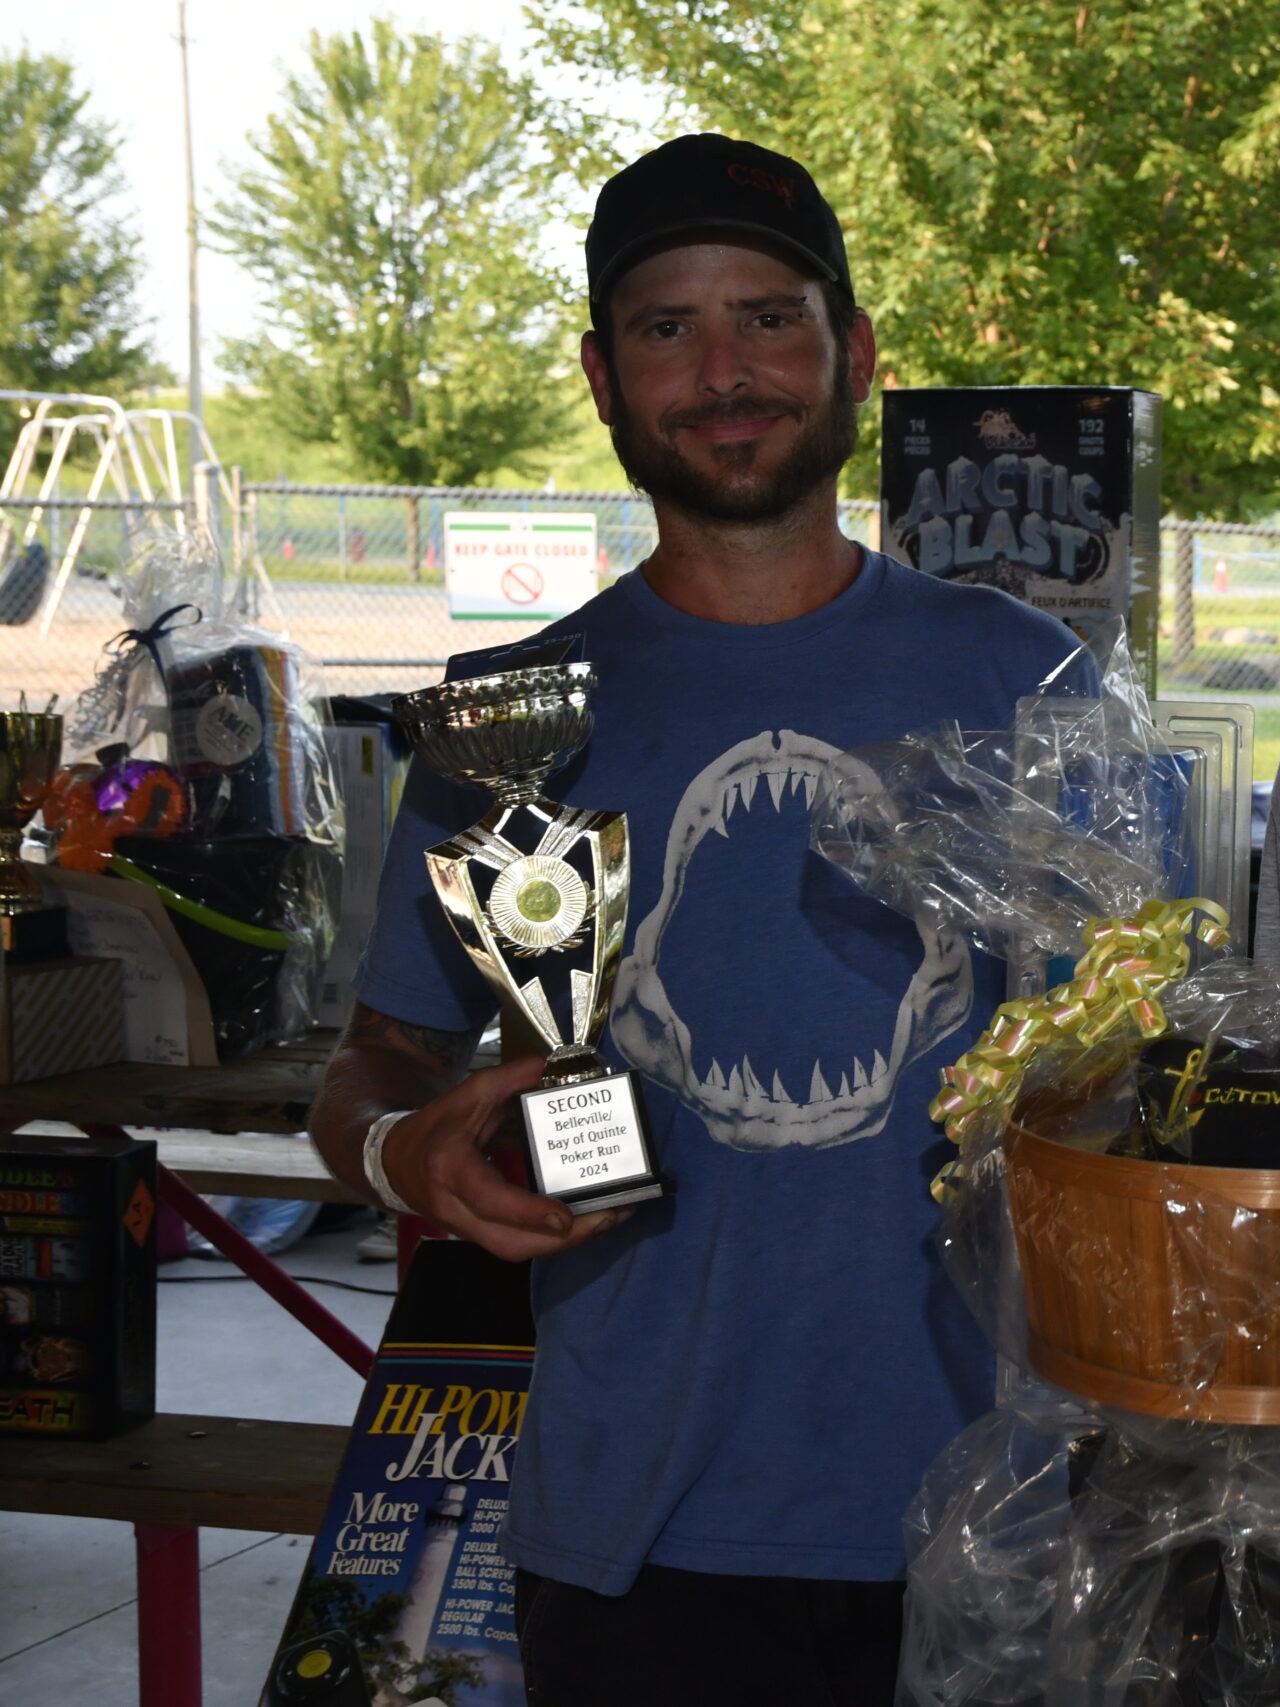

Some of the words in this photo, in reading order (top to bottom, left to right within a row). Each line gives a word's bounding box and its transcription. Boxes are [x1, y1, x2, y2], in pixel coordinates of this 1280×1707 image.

[908, 418, 926, 433] 14
[1078, 418, 1105, 433] 192
[905, 453, 1103, 535] ARCTIC
[454, 544, 488, 557] KEEP
[495, 544, 528, 557] GATE
[535, 544, 588, 557] CLOSED
[918, 509, 1091, 584] BLAST
[547, 1089, 612, 1114] SECOND
[555, 1110, 613, 1131] Belleville/
[547, 1137, 570, 1151] Bay
[573, 1132, 585, 1145] of
[587, 1125, 627, 1142] Quinte
[561, 1148, 593, 1164] Poker
[598, 1144, 621, 1157] Run
[579, 1163, 609, 1178] 2024
[367, 1384, 435, 1435] HI
[385, 1413, 519, 1482] JACK
[344, 1492, 420, 1524] More
[469, 1522, 494, 1534] 3000
[335, 1525, 410, 1553] Great
[463, 1541, 498, 1553] DELUXE
[326, 1551, 402, 1576] Features
[455, 1566, 476, 1577] BALL
[478, 1567, 516, 1580] SCREW
[451, 1579, 477, 1590] 3500
[477, 1580, 495, 1591] lbs.
[444, 1598, 493, 1611] HI-POWER
[441, 1611, 485, 1623] REGULAR
[436, 1624, 462, 1635] 2500
[462, 1624, 480, 1636] lbs.
